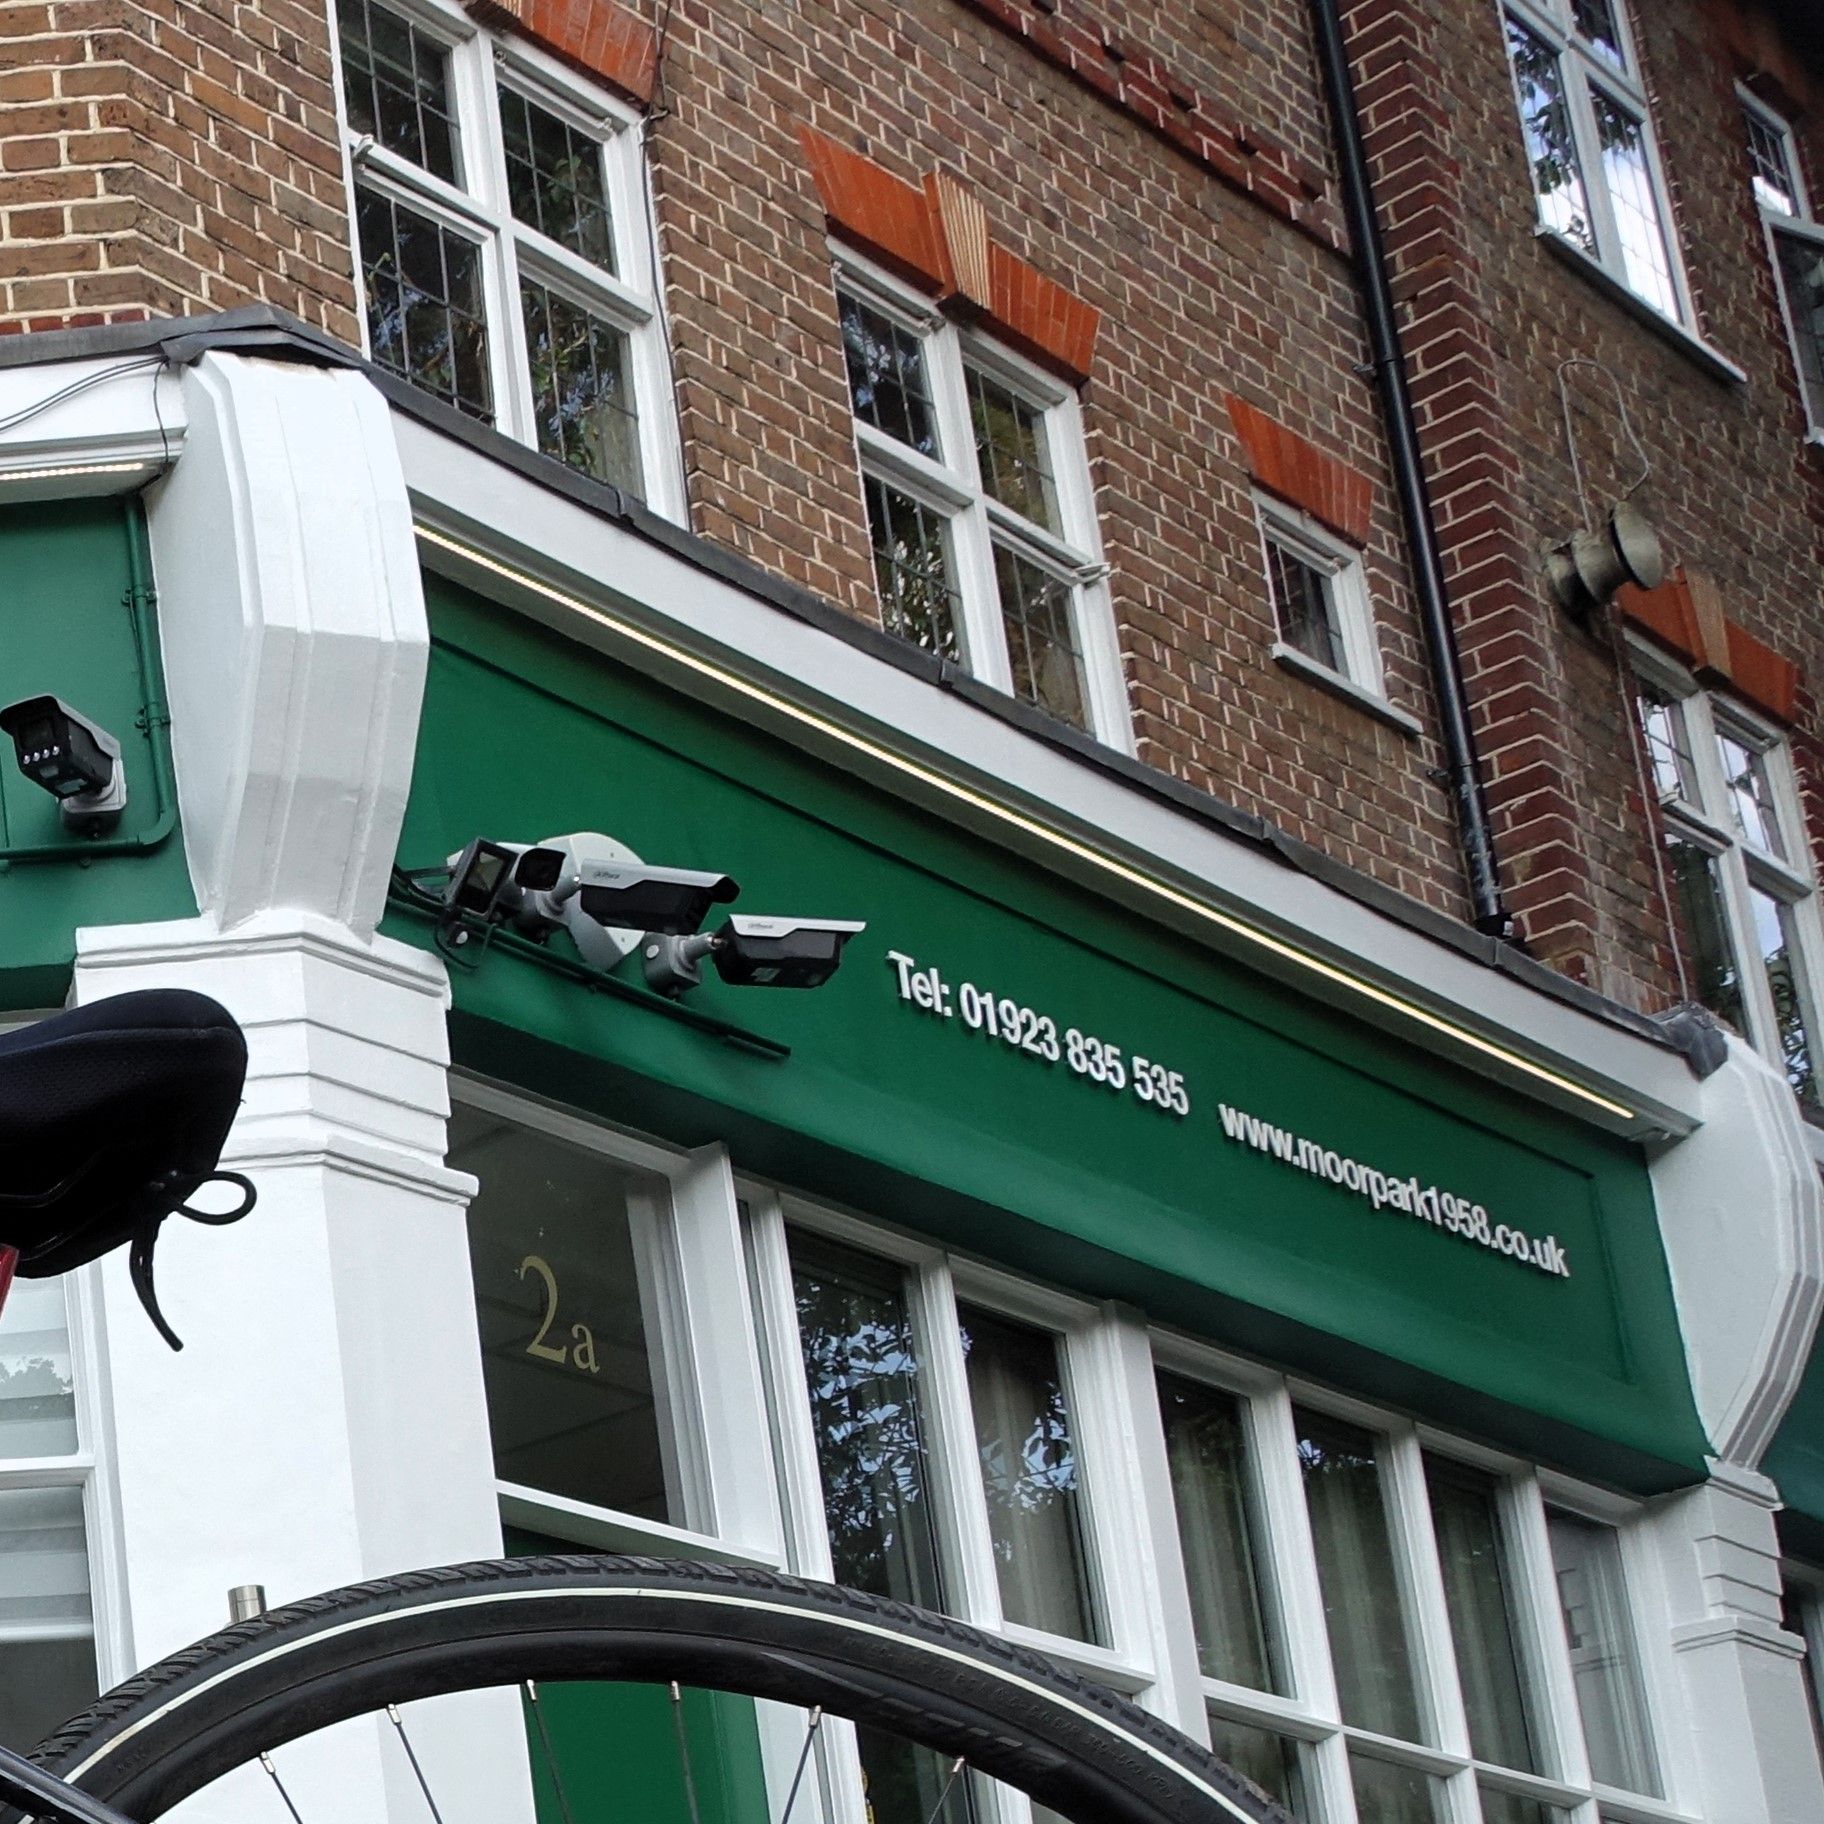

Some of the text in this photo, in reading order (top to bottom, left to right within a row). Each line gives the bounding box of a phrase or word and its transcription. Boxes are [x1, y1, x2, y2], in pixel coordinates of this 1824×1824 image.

[887, 949, 1190, 1115] Tel: 01923 835 535
[1217, 1102, 1570, 1278] www.moorpark1958.co.uk
[519, 1255, 601, 1374] 2a
